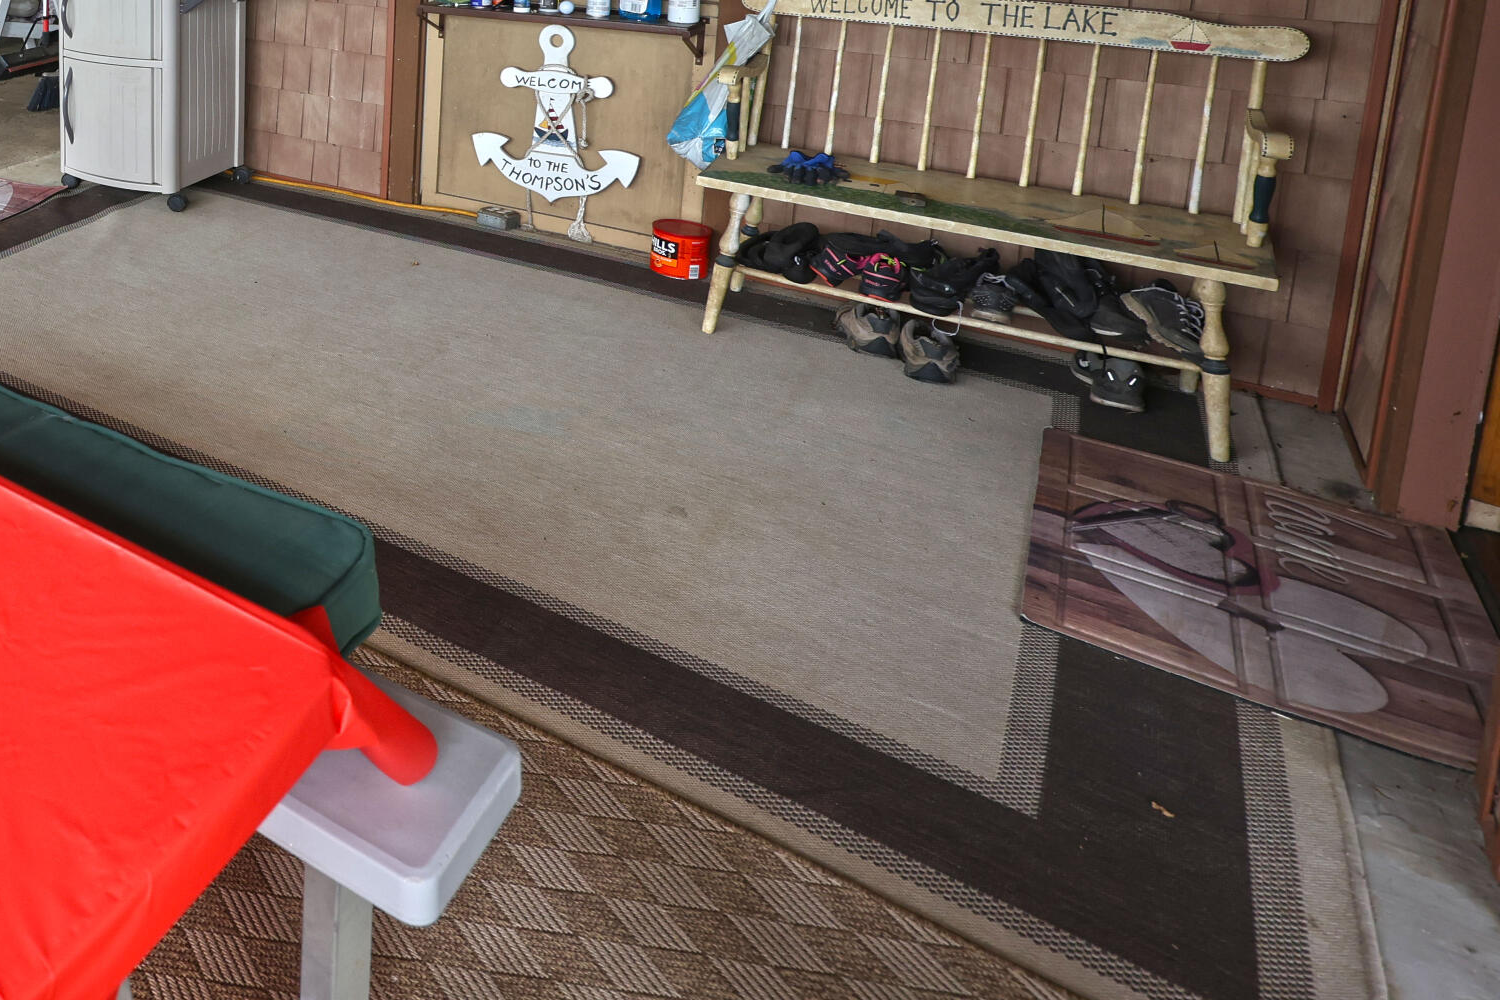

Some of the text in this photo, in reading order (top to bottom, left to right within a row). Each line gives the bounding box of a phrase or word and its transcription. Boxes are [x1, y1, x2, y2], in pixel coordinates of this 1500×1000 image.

[925, 0, 960, 22] TO
[980, 2, 1034, 29] THE
[1043, 6, 1119, 37] LAKE
[500, 158, 602, 192] THOMPSON'S
[546, 160, 569, 174] THE
